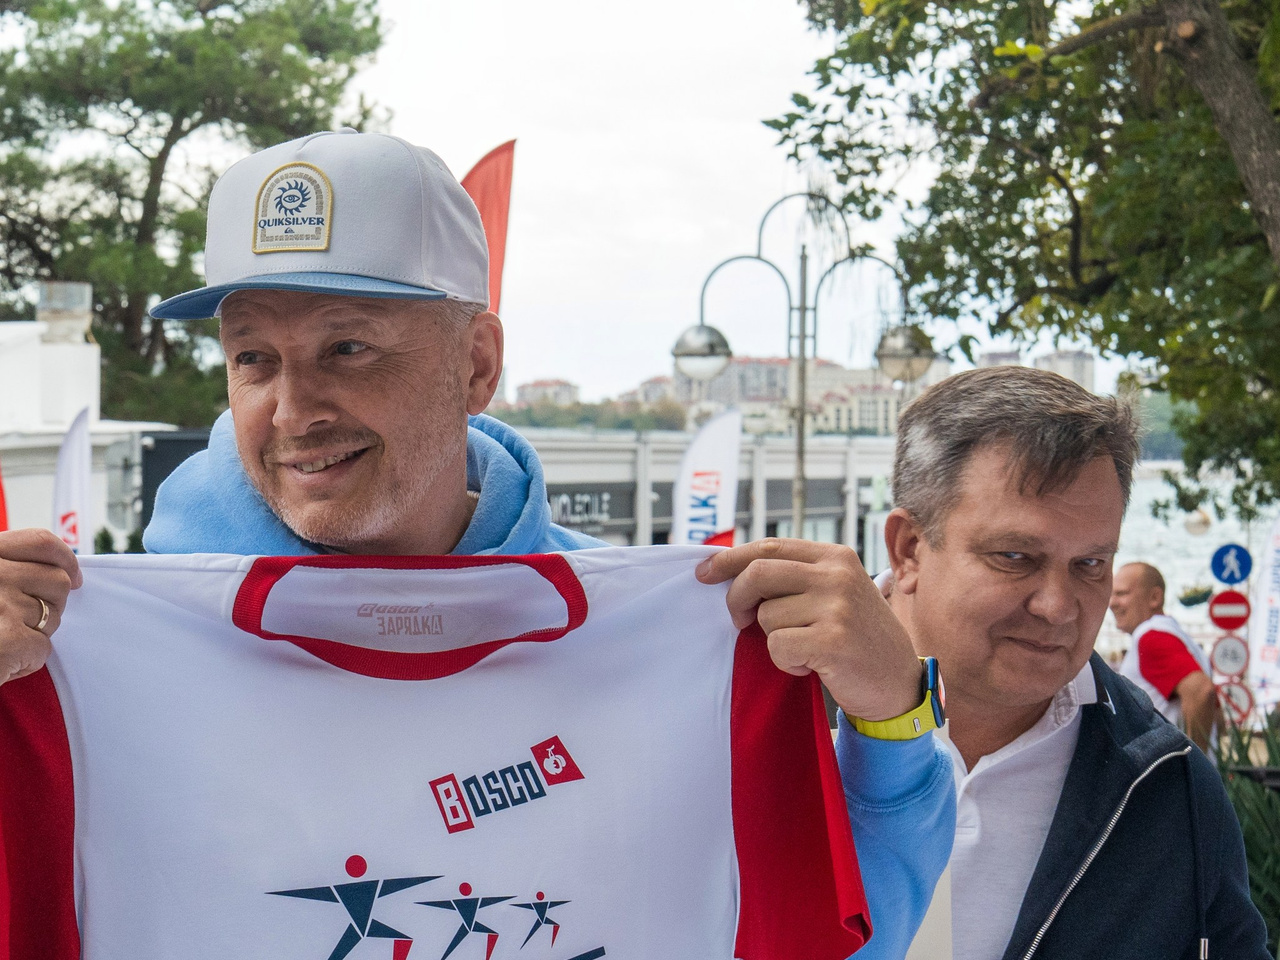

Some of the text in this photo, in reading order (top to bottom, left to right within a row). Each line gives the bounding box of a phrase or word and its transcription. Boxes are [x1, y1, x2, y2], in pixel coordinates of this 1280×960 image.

[258, 217, 325, 229] QUIKSILVER
[377, 615, 443, 635] ЗАРЯДКА
[429, 760, 547, 834] BOSCO
